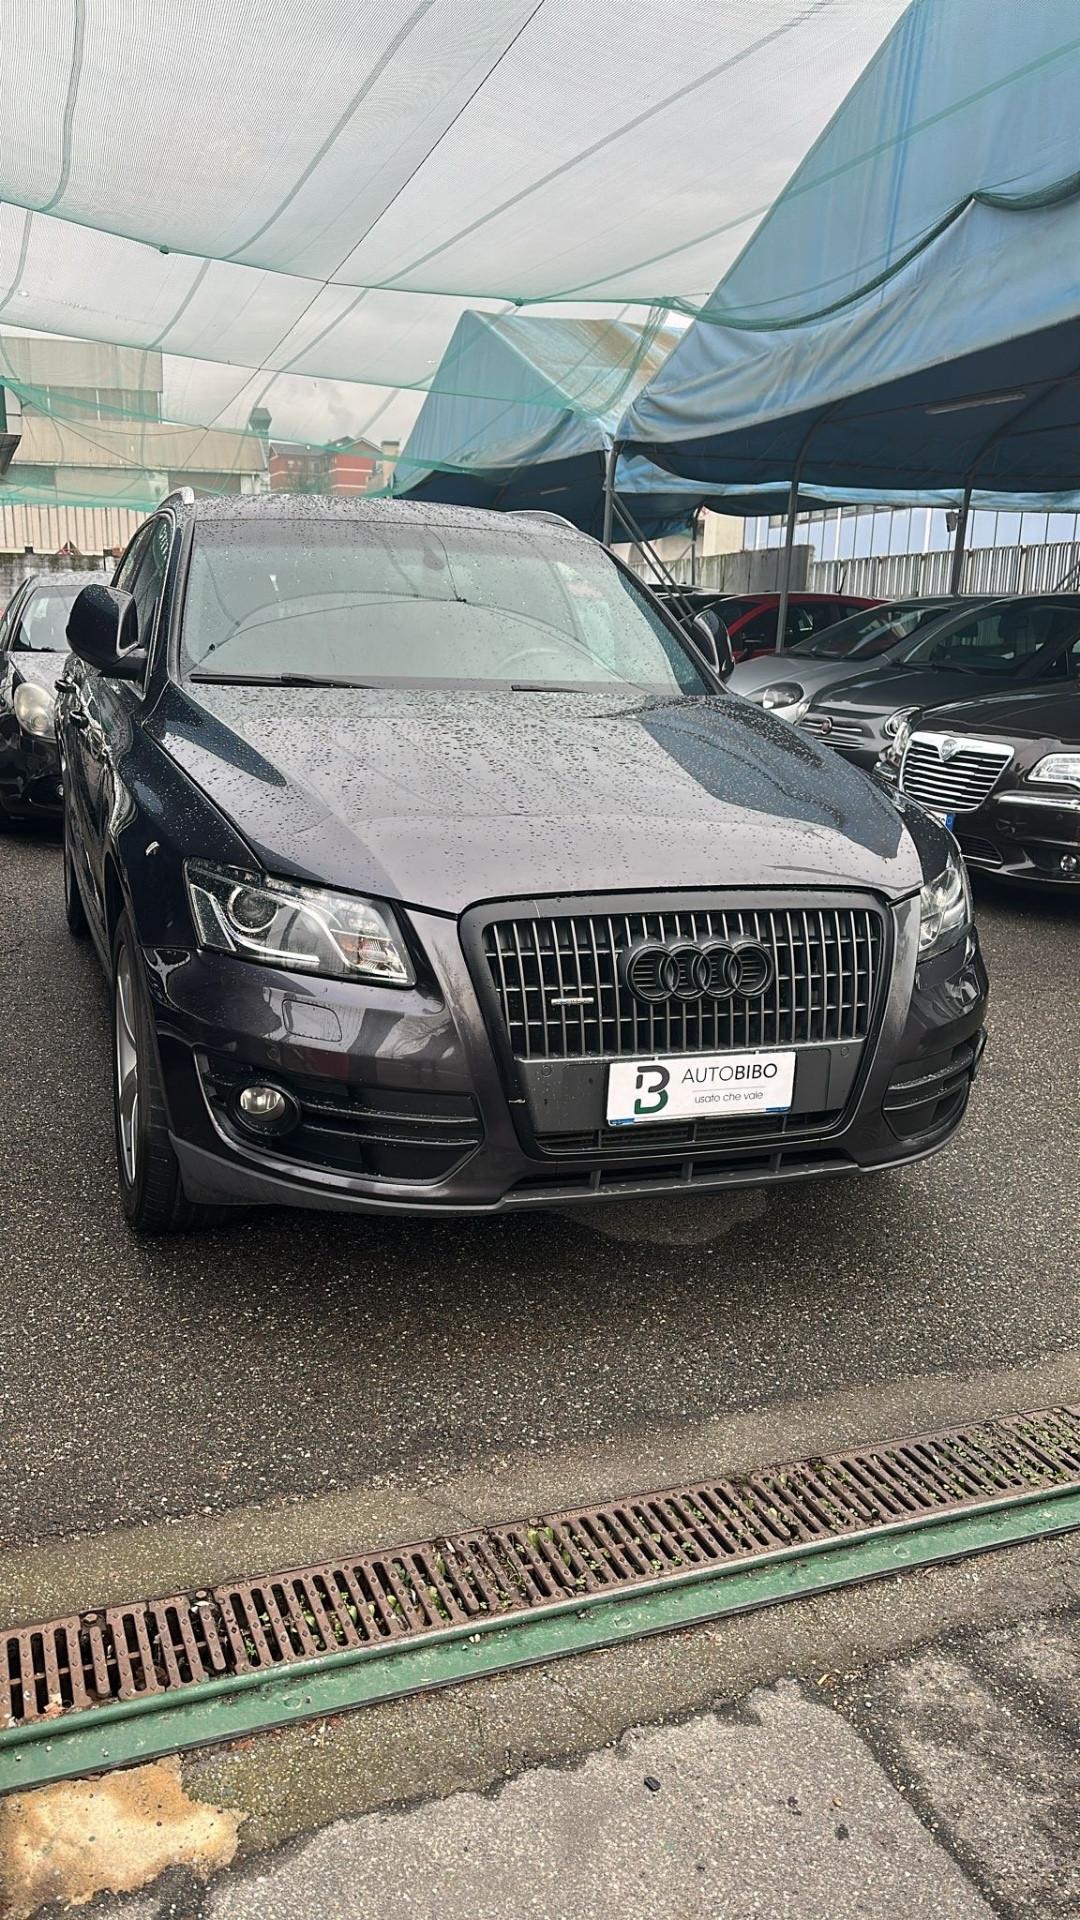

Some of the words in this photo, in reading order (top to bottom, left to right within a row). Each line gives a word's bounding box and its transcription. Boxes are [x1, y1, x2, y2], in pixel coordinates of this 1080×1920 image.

[681, 1063, 778, 1084] AUTOBIBO
[694, 1093, 720, 1104] usato
[722, 1092, 742, 1102] che
[743, 1090, 764, 1101] vale
